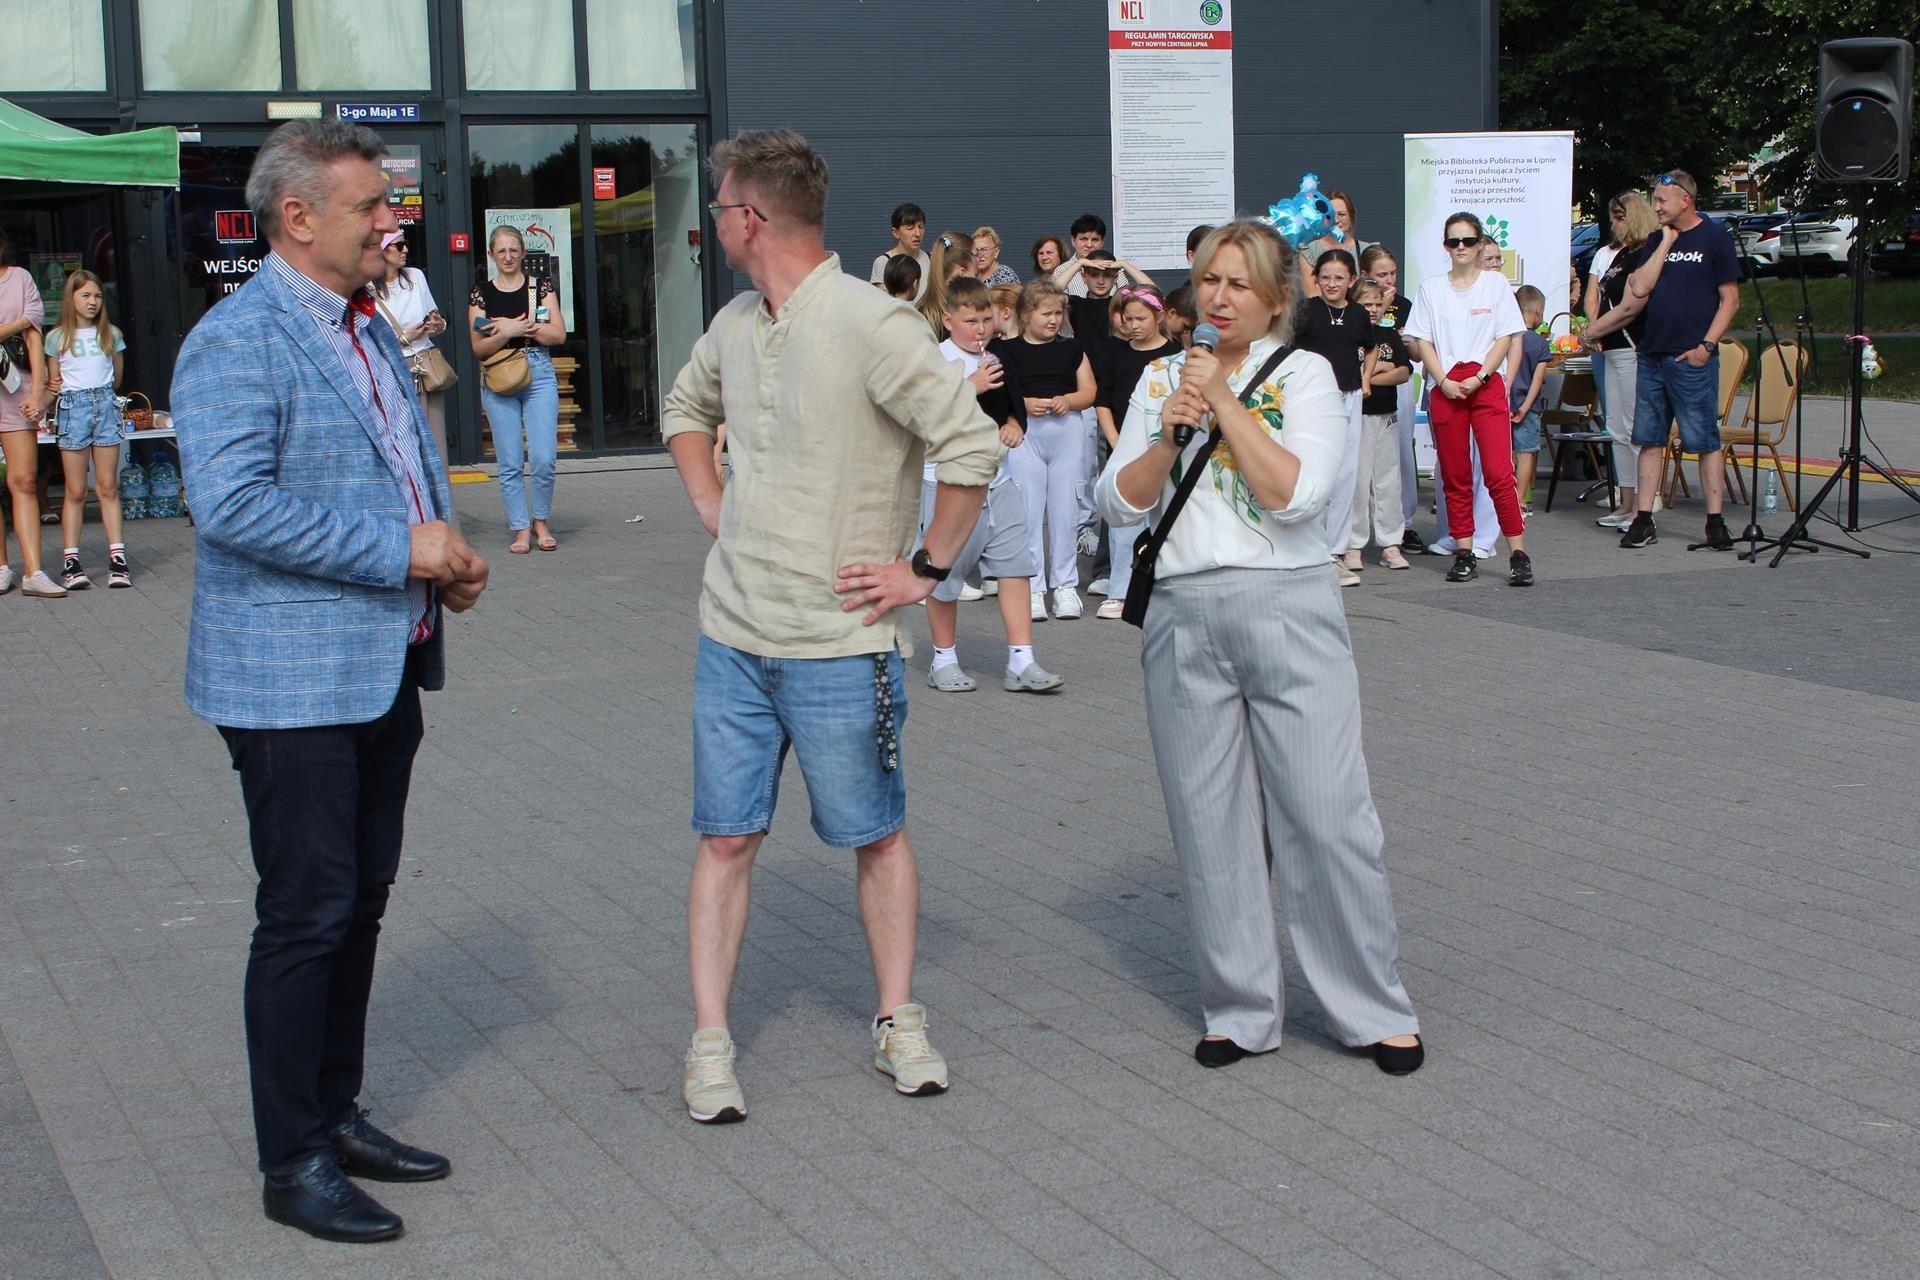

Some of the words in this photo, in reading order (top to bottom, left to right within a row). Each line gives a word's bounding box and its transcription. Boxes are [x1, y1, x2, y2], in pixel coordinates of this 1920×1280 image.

[1121, 1, 1145, 20] NCL
[1125, 32, 1167, 40] REGULAMIN
[1168, 32, 1214, 40] TARGOWISKA
[341, 107, 367, 119] 3-go
[370, 107, 397, 119] Maja
[400, 107, 415, 117] 1E
[381, 159, 416, 168] MOTOCROSS
[1420, 158, 1449, 167] Miejska
[1450, 157, 1488, 165] Biblioteka
[1489, 156, 1525, 165] Publiczna
[1534, 155, 1557, 164] Lipnie
[1438, 168, 1474, 176] przyjazna
[1478, 167, 1513, 177] pulsująca
[1514, 166, 1540, 176] życiem
[1455, 178, 1491, 186] instytucja
[1450, 187, 1486, 195] szanująca
[1487, 185, 1526, 195] przeszłość
[1454, 197, 1486, 206] kreująca
[217, 212, 255, 239] NCL
[1664, 250, 1704, 263] ebok
[203, 256, 263, 274] WEJŚCI
[224, 282, 241, 293] nr
